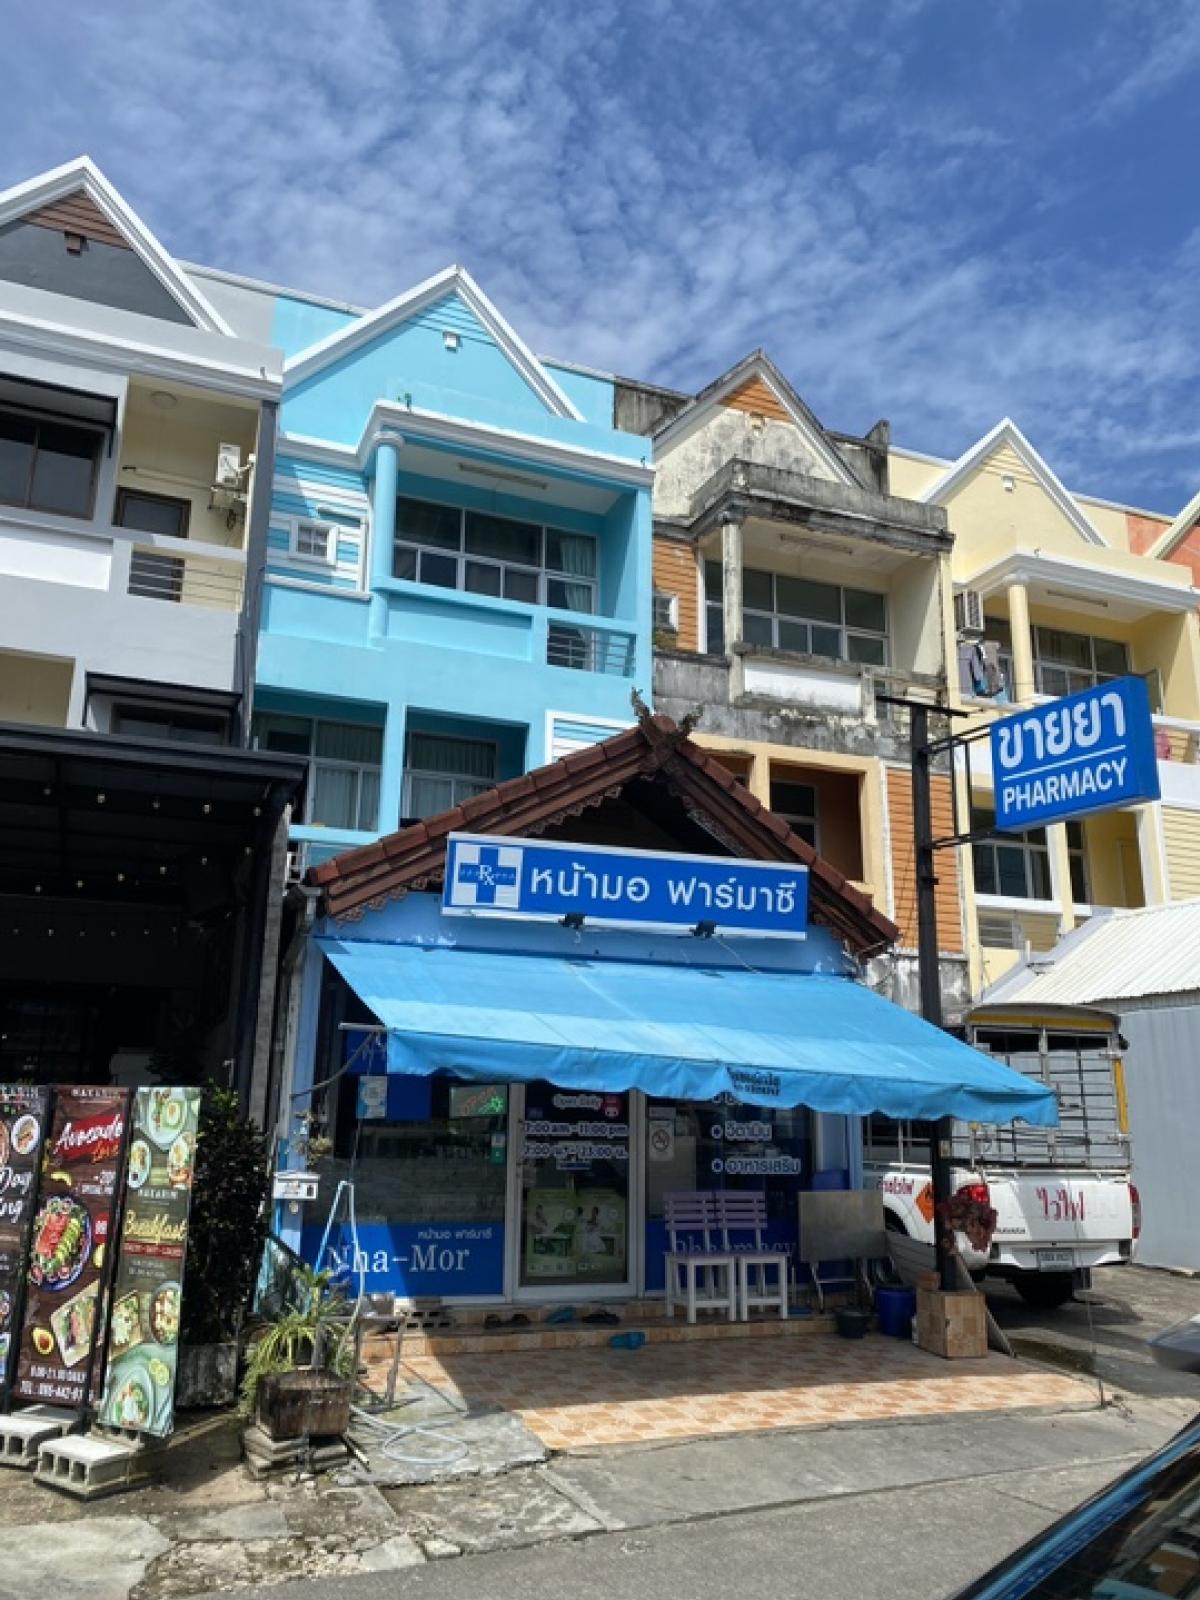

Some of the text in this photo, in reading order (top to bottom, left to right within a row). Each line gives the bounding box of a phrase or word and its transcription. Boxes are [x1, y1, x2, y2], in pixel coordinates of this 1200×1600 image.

[998, 692, 1126, 768] ขายยา
[1003, 757, 1128, 814] PHARMACY
[530, 862, 650, 903] หน้ามอ
